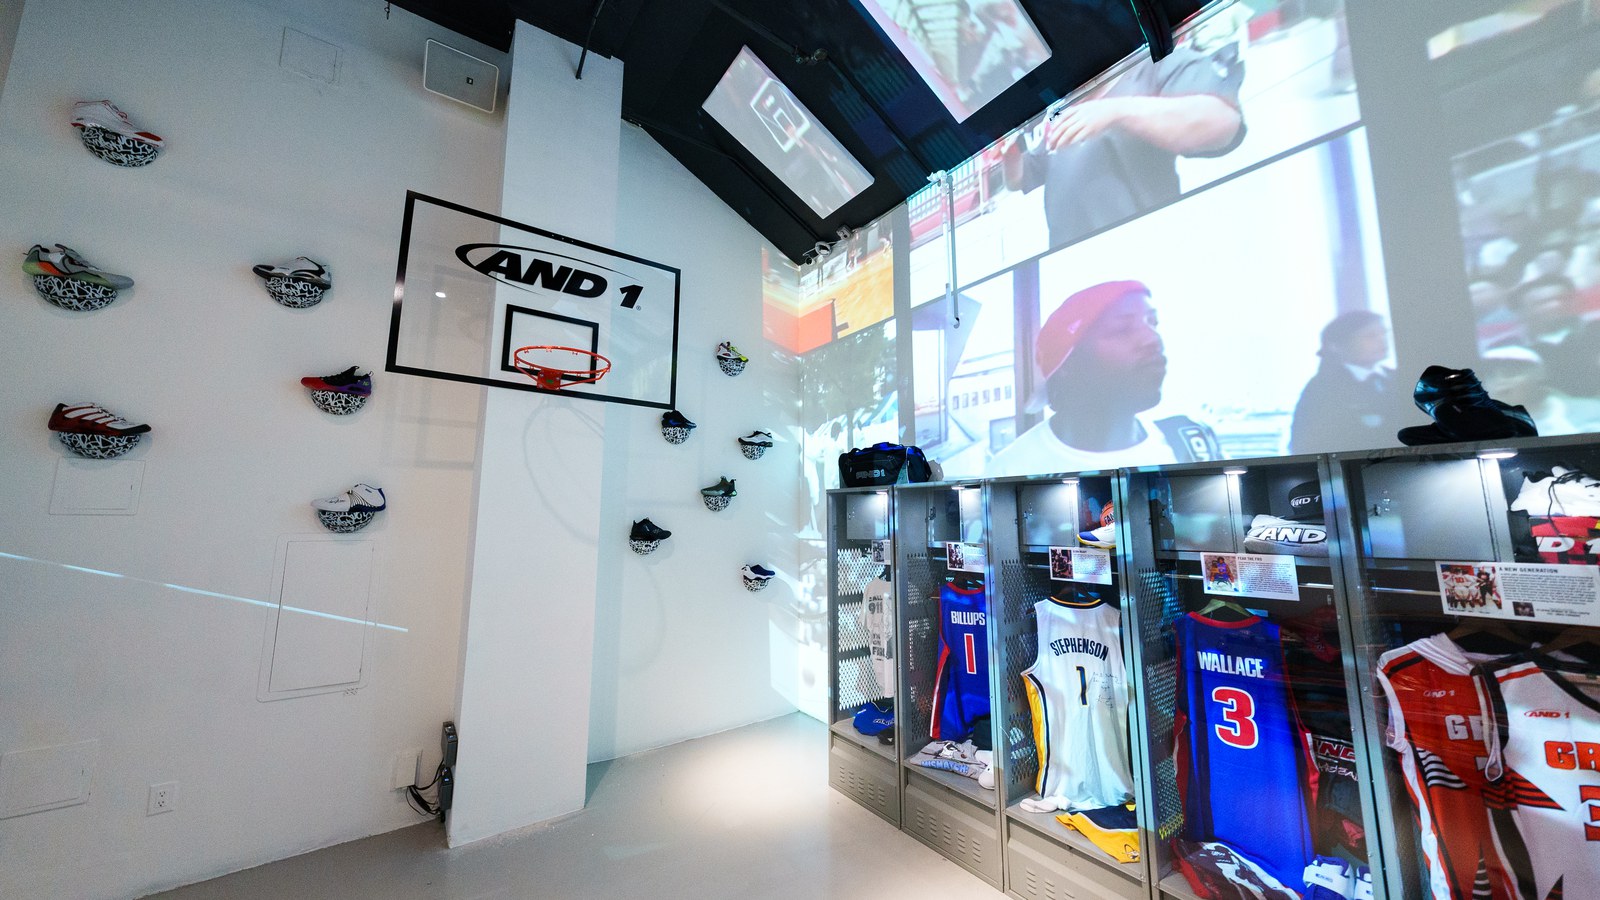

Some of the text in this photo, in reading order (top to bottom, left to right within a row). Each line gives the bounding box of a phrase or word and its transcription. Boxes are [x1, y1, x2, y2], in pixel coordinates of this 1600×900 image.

[475, 249, 644, 309] AND 1
[1262, 527, 1327, 543] AND
[951, 610, 986, 626] BILLUPS
[964, 633, 977, 674] 1
[1050, 637, 1109, 662] STEPHENSON
[1197, 651, 1265, 679] WALLACE
[1075, 665, 1088, 706] 1
[1211, 686, 1259, 749] 3
